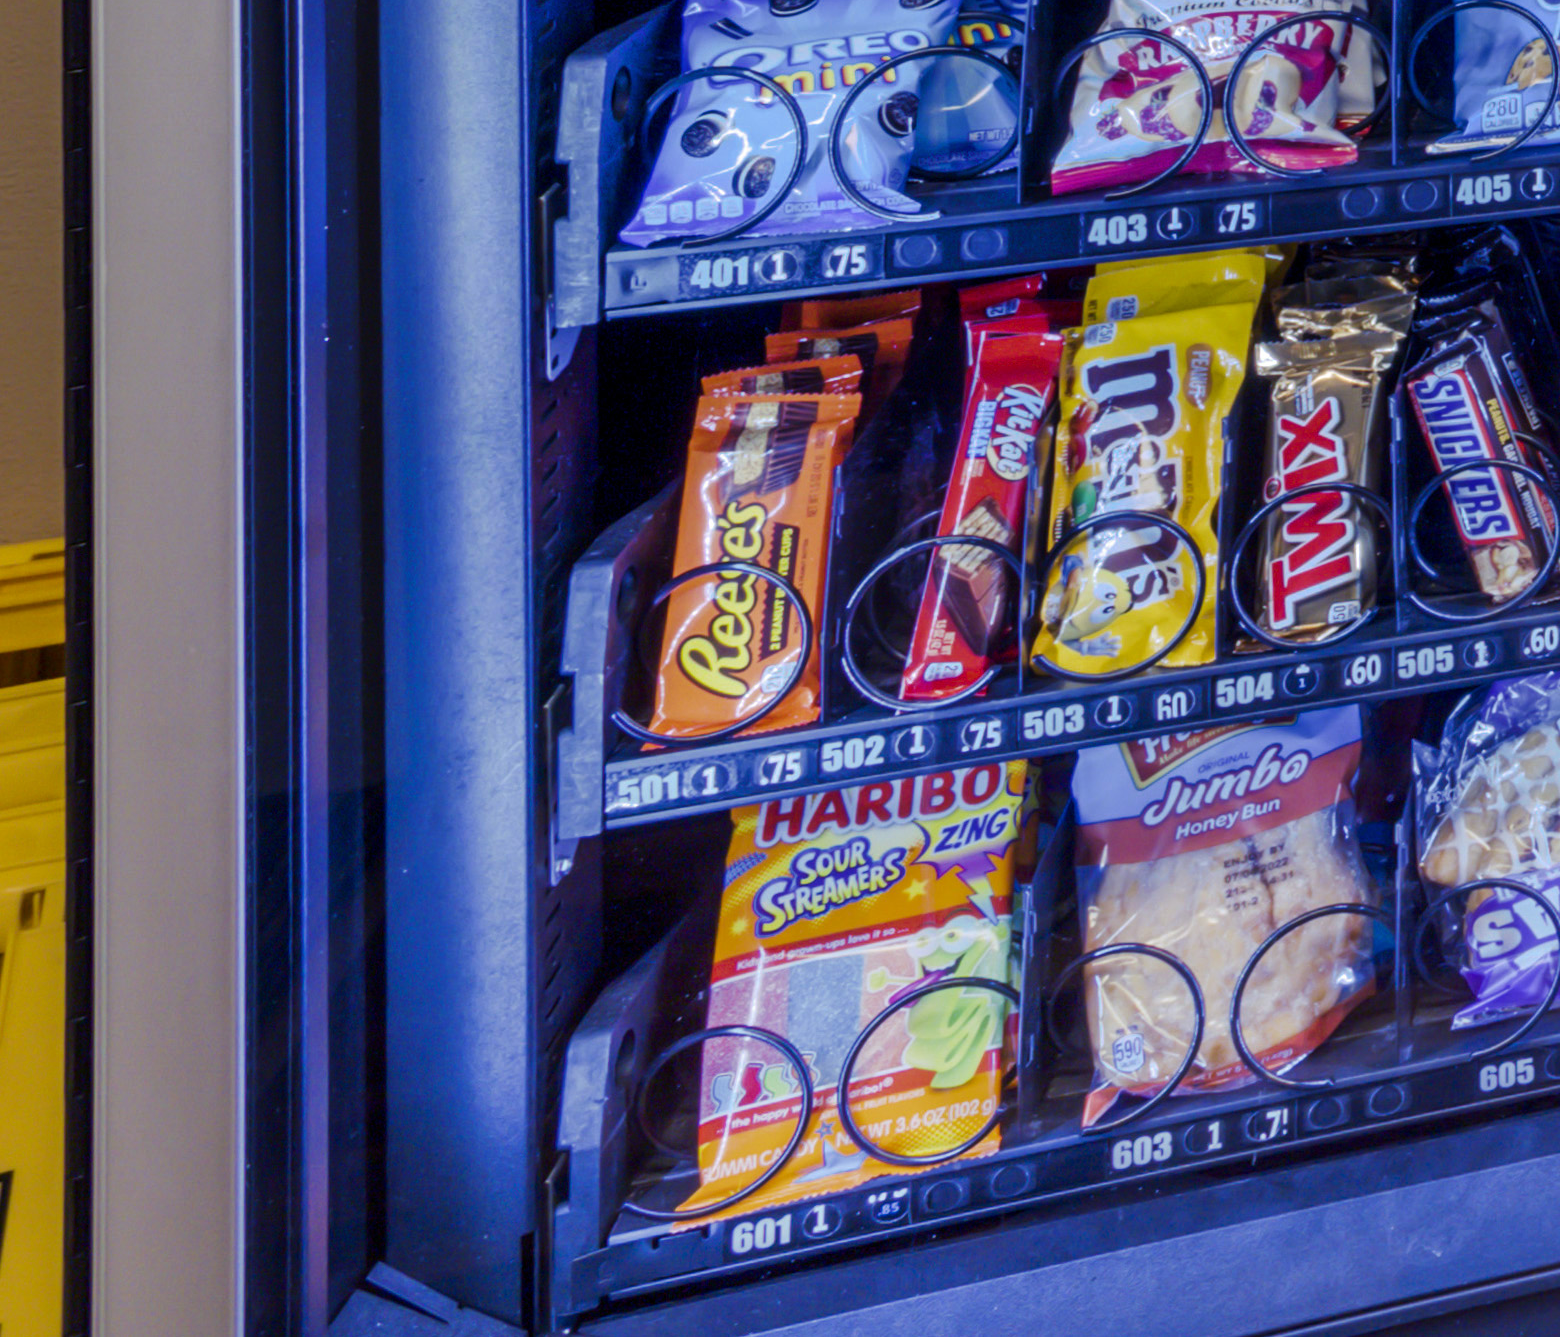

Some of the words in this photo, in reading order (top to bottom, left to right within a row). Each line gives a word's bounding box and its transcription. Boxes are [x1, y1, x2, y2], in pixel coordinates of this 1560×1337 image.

[707, 29, 930, 86] OREO
[1455, 174, 1513, 205] 405
[1216, 672, 1274, 707] 504
[822, 736, 886, 773] 502
[618, 770, 680, 815] 501
[757, 763, 1003, 842] HARIBO
[1143, 742, 1311, 827] Jumbo
[1175, 809, 1240, 841] Honey
[1242, 797, 1281, 823] Bun
[796, 836, 869, 880] SOUR
[759, 852, 903, 933] STREAMERS
[1112, 1132, 1173, 1169] 603
[731, 1215, 792, 1254] 601
